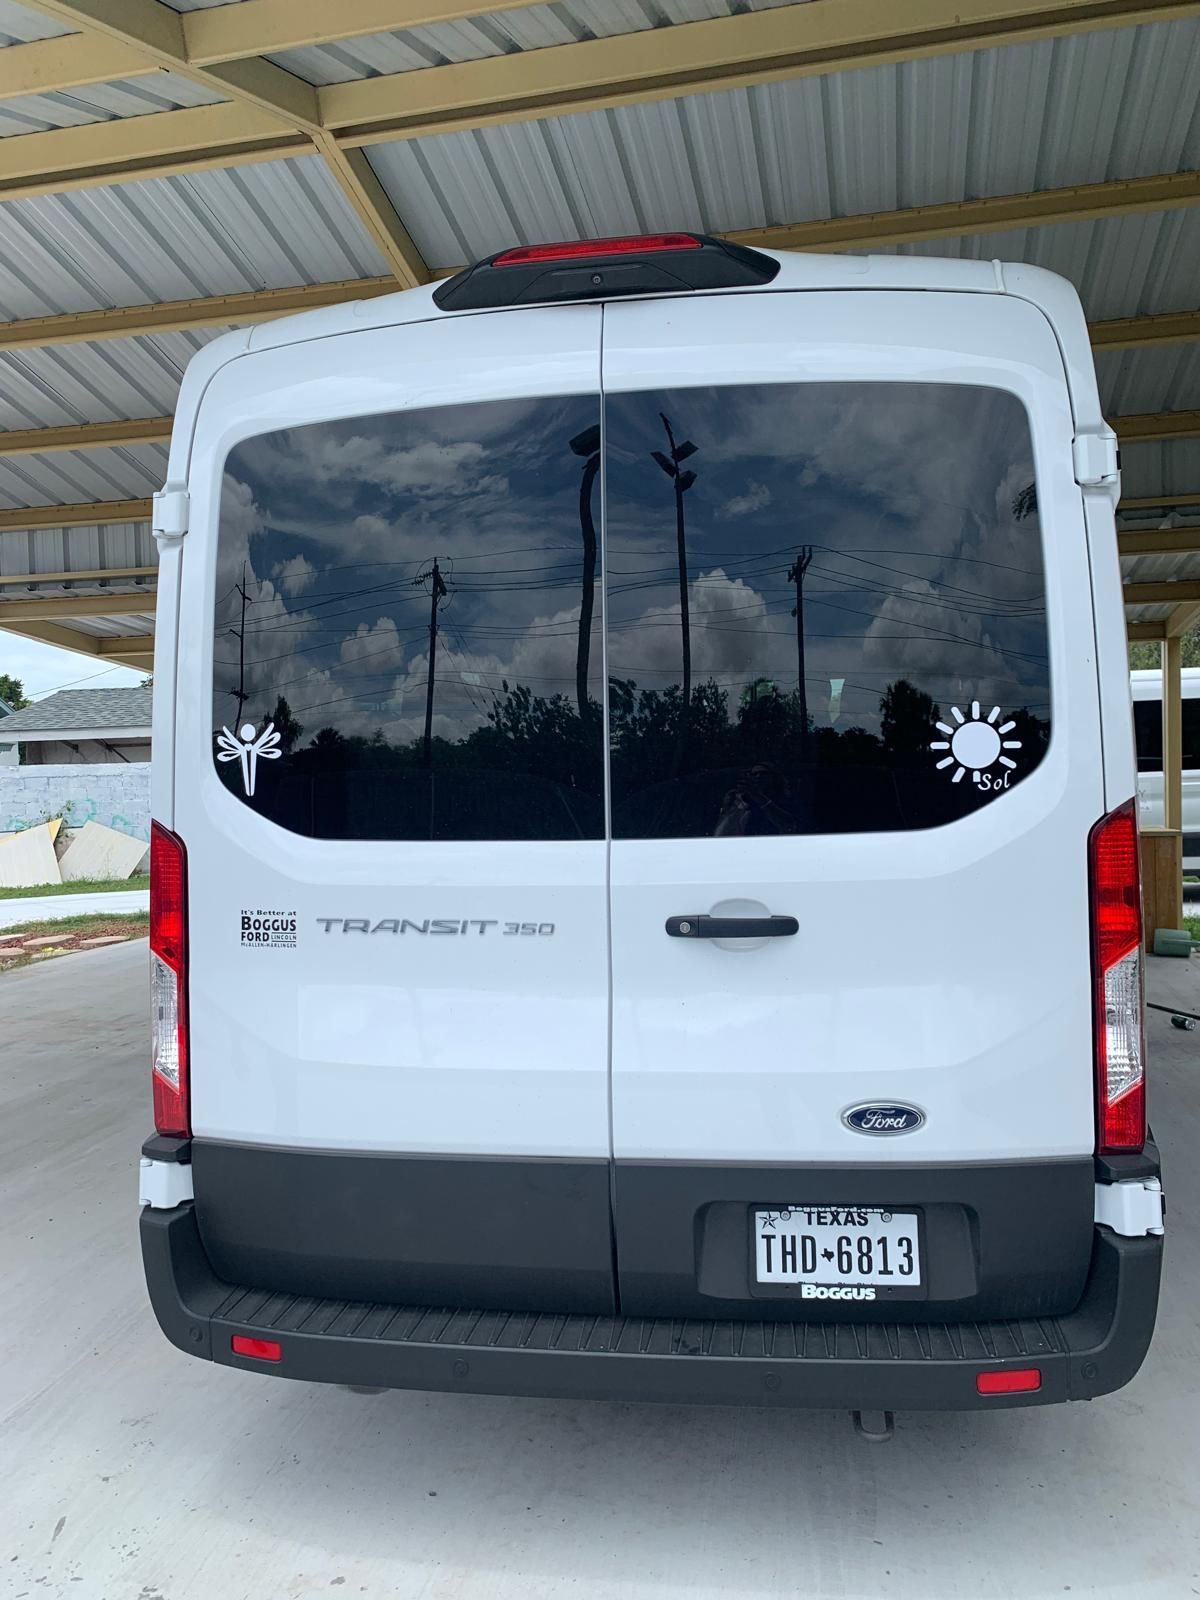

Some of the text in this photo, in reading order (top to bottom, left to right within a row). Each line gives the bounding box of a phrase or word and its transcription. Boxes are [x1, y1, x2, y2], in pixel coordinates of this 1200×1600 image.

[977, 770, 1011, 790] Sol
[241, 916, 296, 931] BOGGUS
[316, 918, 555, 937] TRANSIT 350
[241, 931, 270, 942] FORD
[861, 1109, 907, 1129] Ford
[804, 1211, 869, 1226] TEXAS
[801, 1284, 876, 1301] BOGGUS
